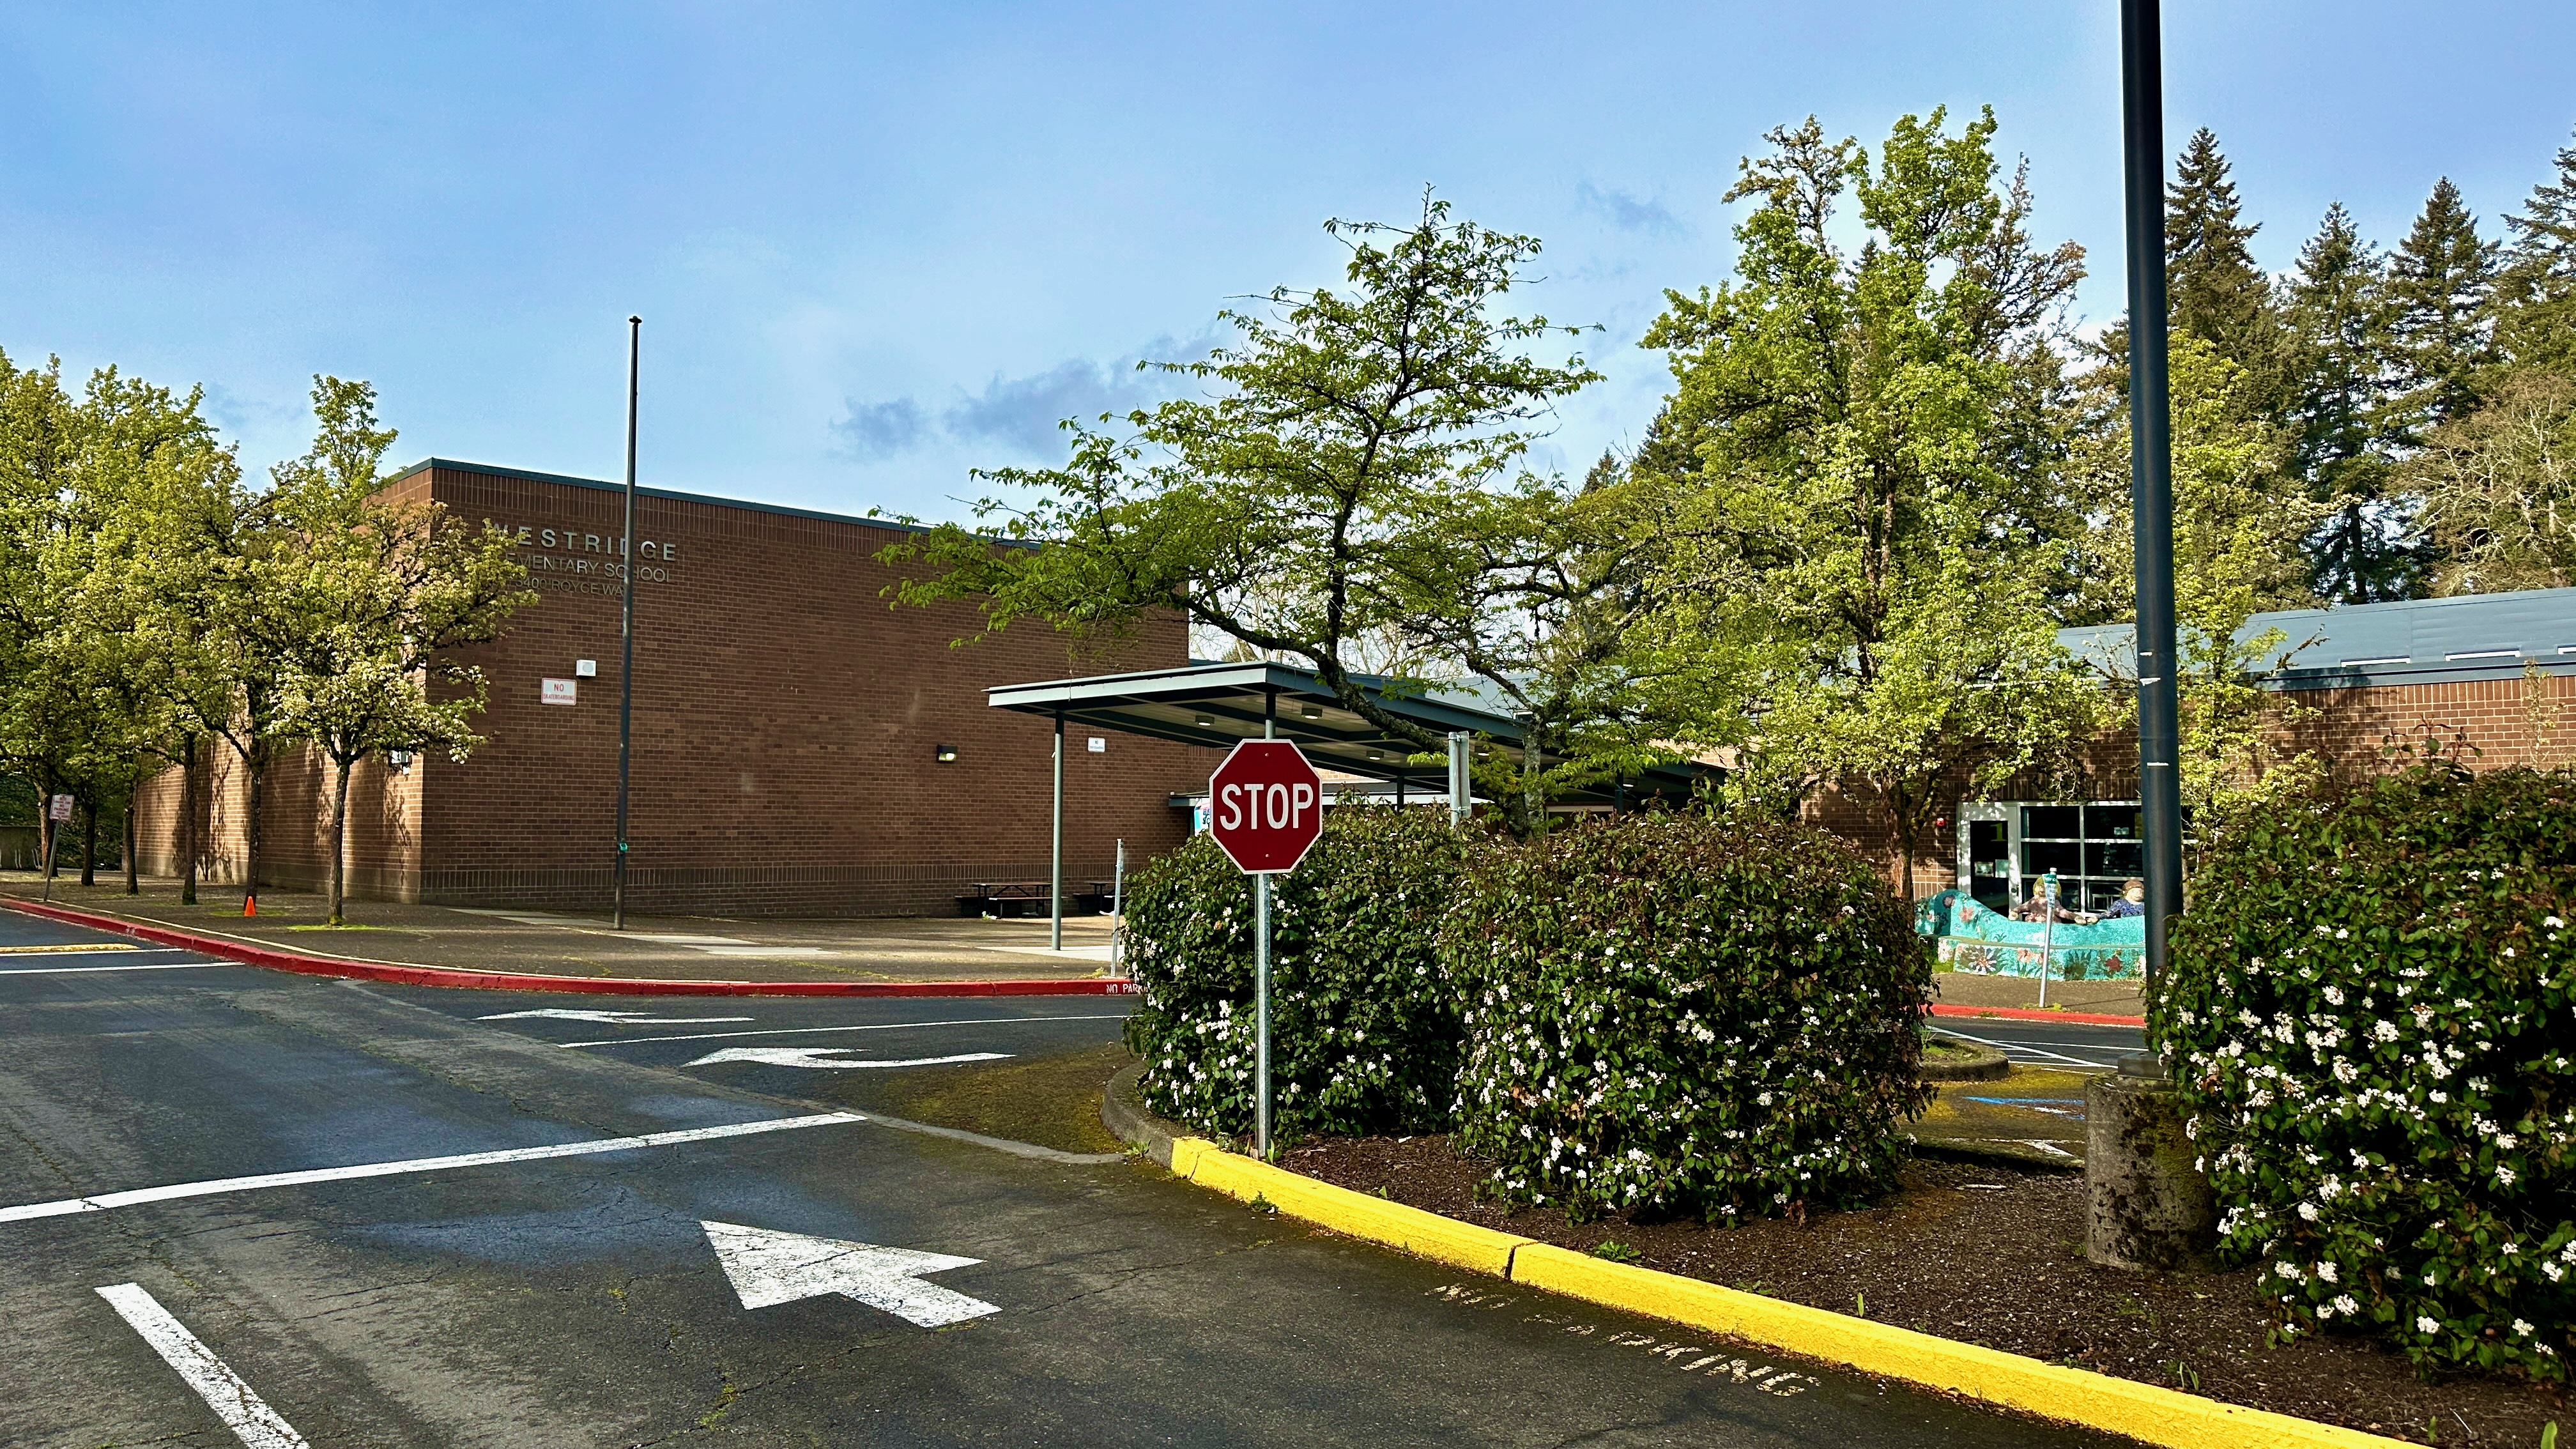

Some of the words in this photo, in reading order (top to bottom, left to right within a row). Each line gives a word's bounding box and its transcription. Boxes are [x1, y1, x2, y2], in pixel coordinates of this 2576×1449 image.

[505, 552, 599, 575] EMENTARY
[551, 579, 599, 594] ROYCE
[602, 584, 625, 597] WA
[554, 683, 565, 692] NO
[1220, 783, 1314, 831] STOP
[1989, 822, 2007, 841] 1
[1106, 983, 1118, 994] NO
